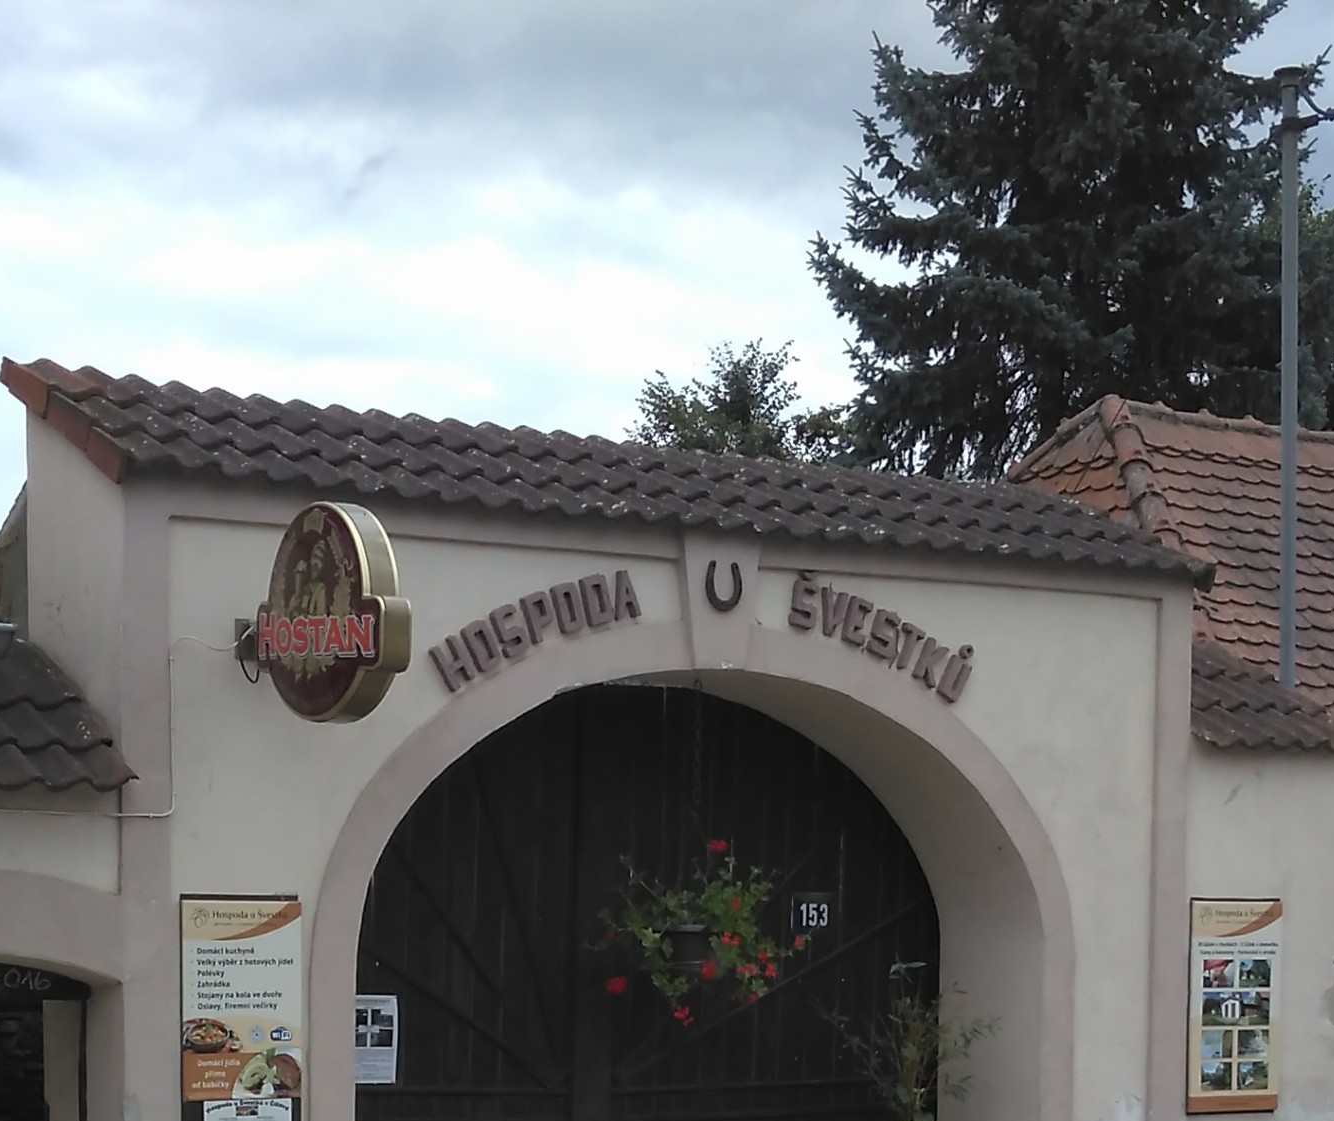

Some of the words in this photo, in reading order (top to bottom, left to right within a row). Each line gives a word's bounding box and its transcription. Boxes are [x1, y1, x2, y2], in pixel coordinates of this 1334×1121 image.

[258, 612, 376, 660] HOSTAN
[428, 569, 642, 693] HOSPODA
[786, 569, 976, 703] ŠVESTKŮ
[212, 909, 248, 921] Hospoda
[800, 903, 828, 927] 153
[225, 946, 254, 956] kuchyně
[197, 959, 216, 967] Velký
[218, 958, 237, 967] výběr
[244, 958, 276, 967] hotových
[197, 969, 224, 978] Polévky
[197, 980, 230, 988] Zahrádka
[197, 992, 223, 1000] Stojany
[262, 990, 282, 998] dvoře
[197, 1003, 223, 1011] Oslavy,
[224, 1002, 250, 1010] firemní
[252, 1001, 278, 1011] večírky
[204, 1070, 226, 1079] přímo
[202, 1080, 229, 1090] babičky
